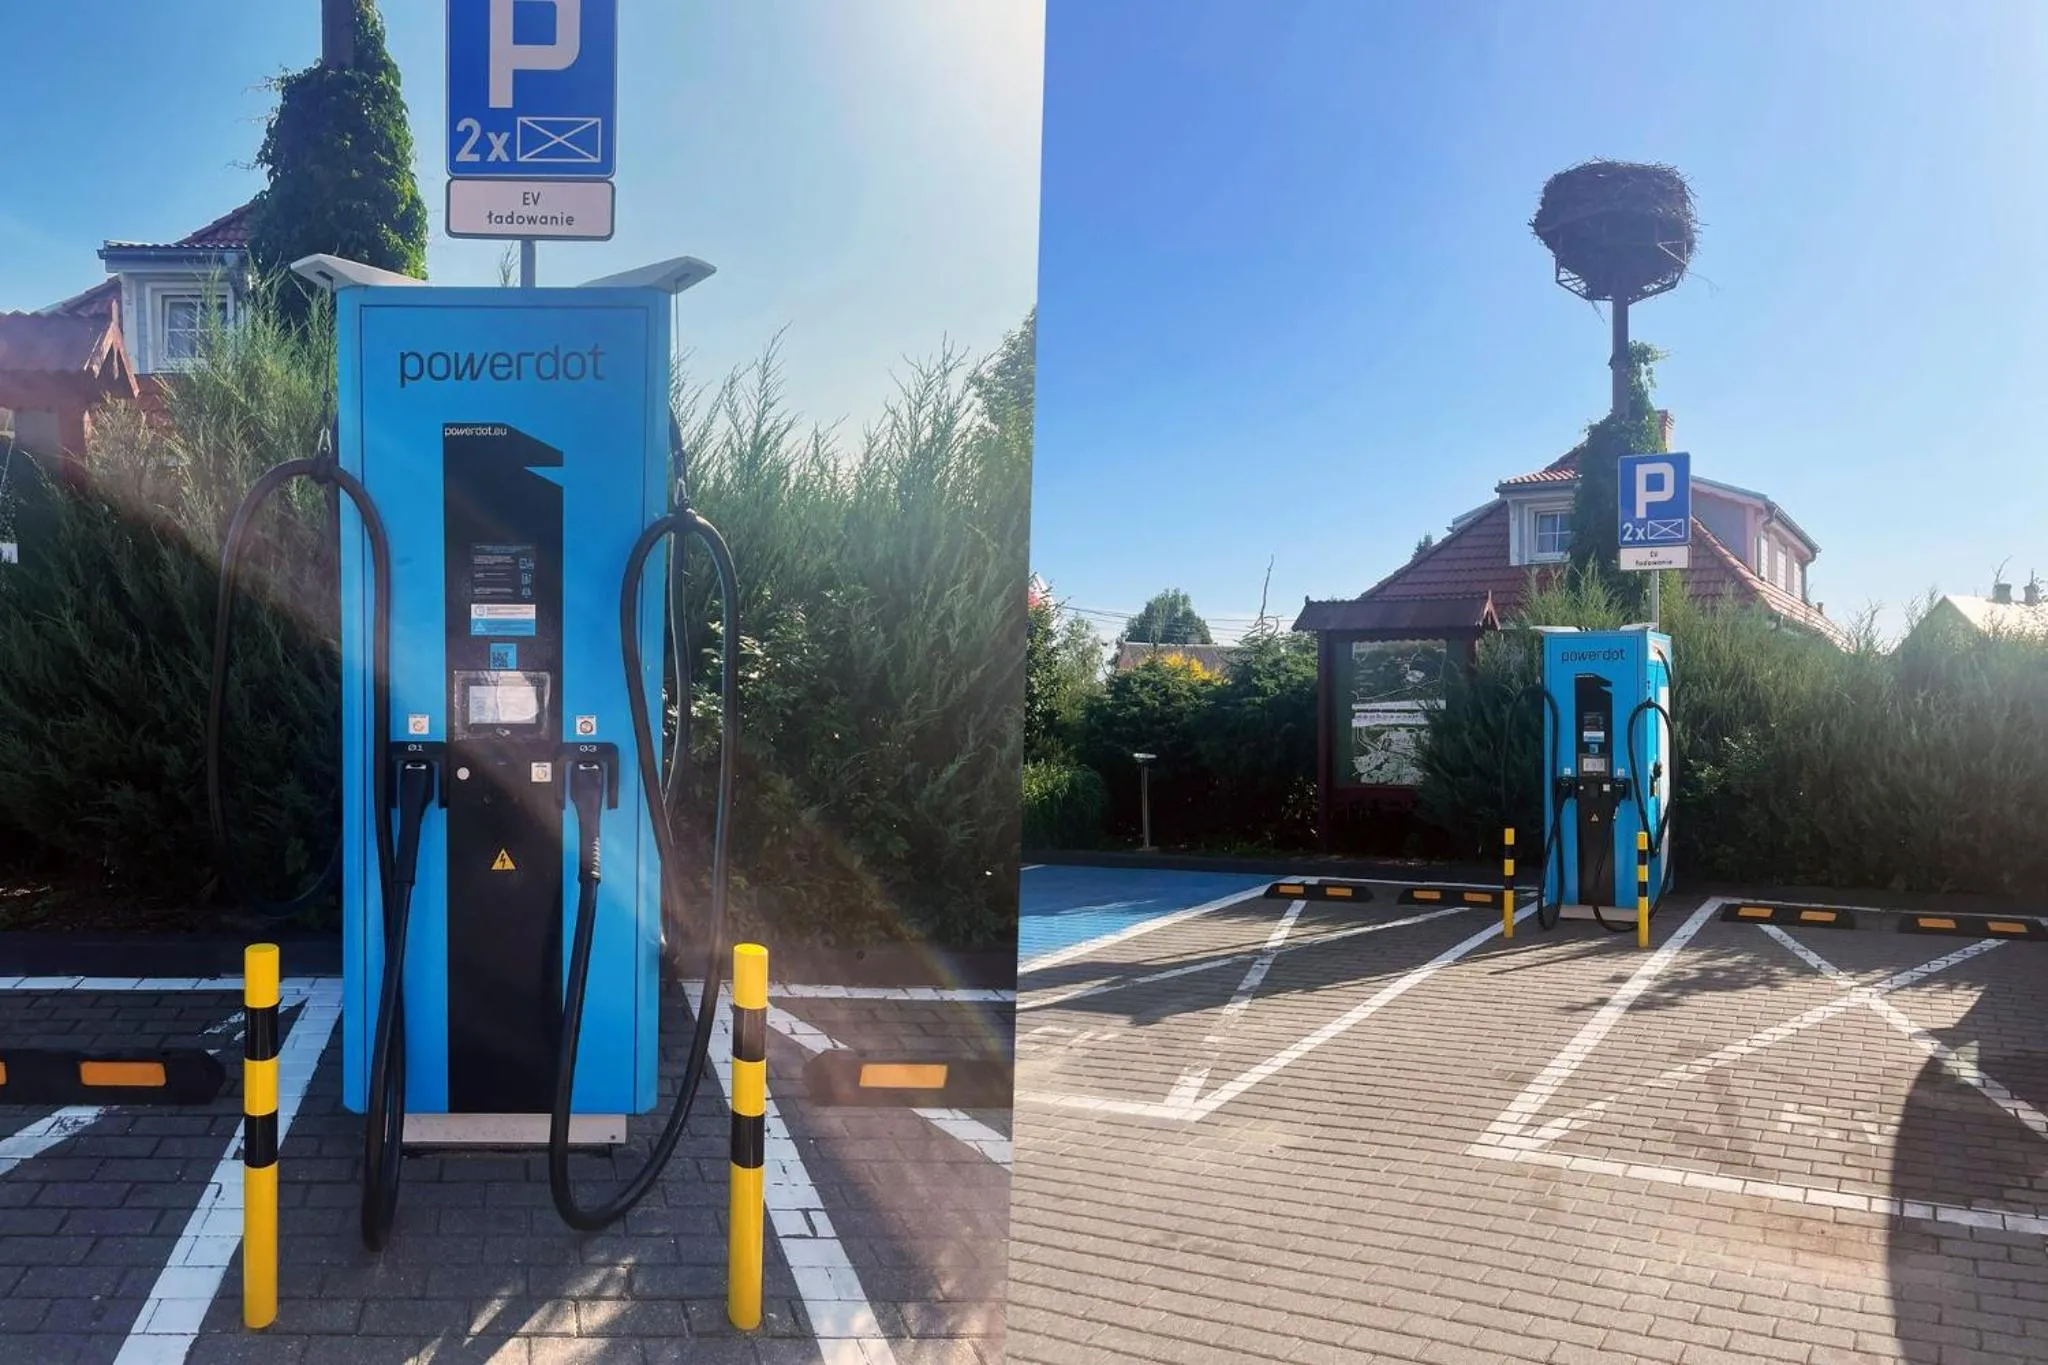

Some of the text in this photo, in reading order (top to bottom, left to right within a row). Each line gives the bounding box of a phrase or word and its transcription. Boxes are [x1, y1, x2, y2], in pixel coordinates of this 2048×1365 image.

[489, 0, 581, 108] P
[522, 191, 541, 206] EV
[487, 210, 575, 226] ładowanie
[400, 343, 606, 388] powerdot
[444, 426, 507, 436] powerdot.eu
[1635, 462, 1675, 519] P
[1561, 648, 1626, 664] powerdot
